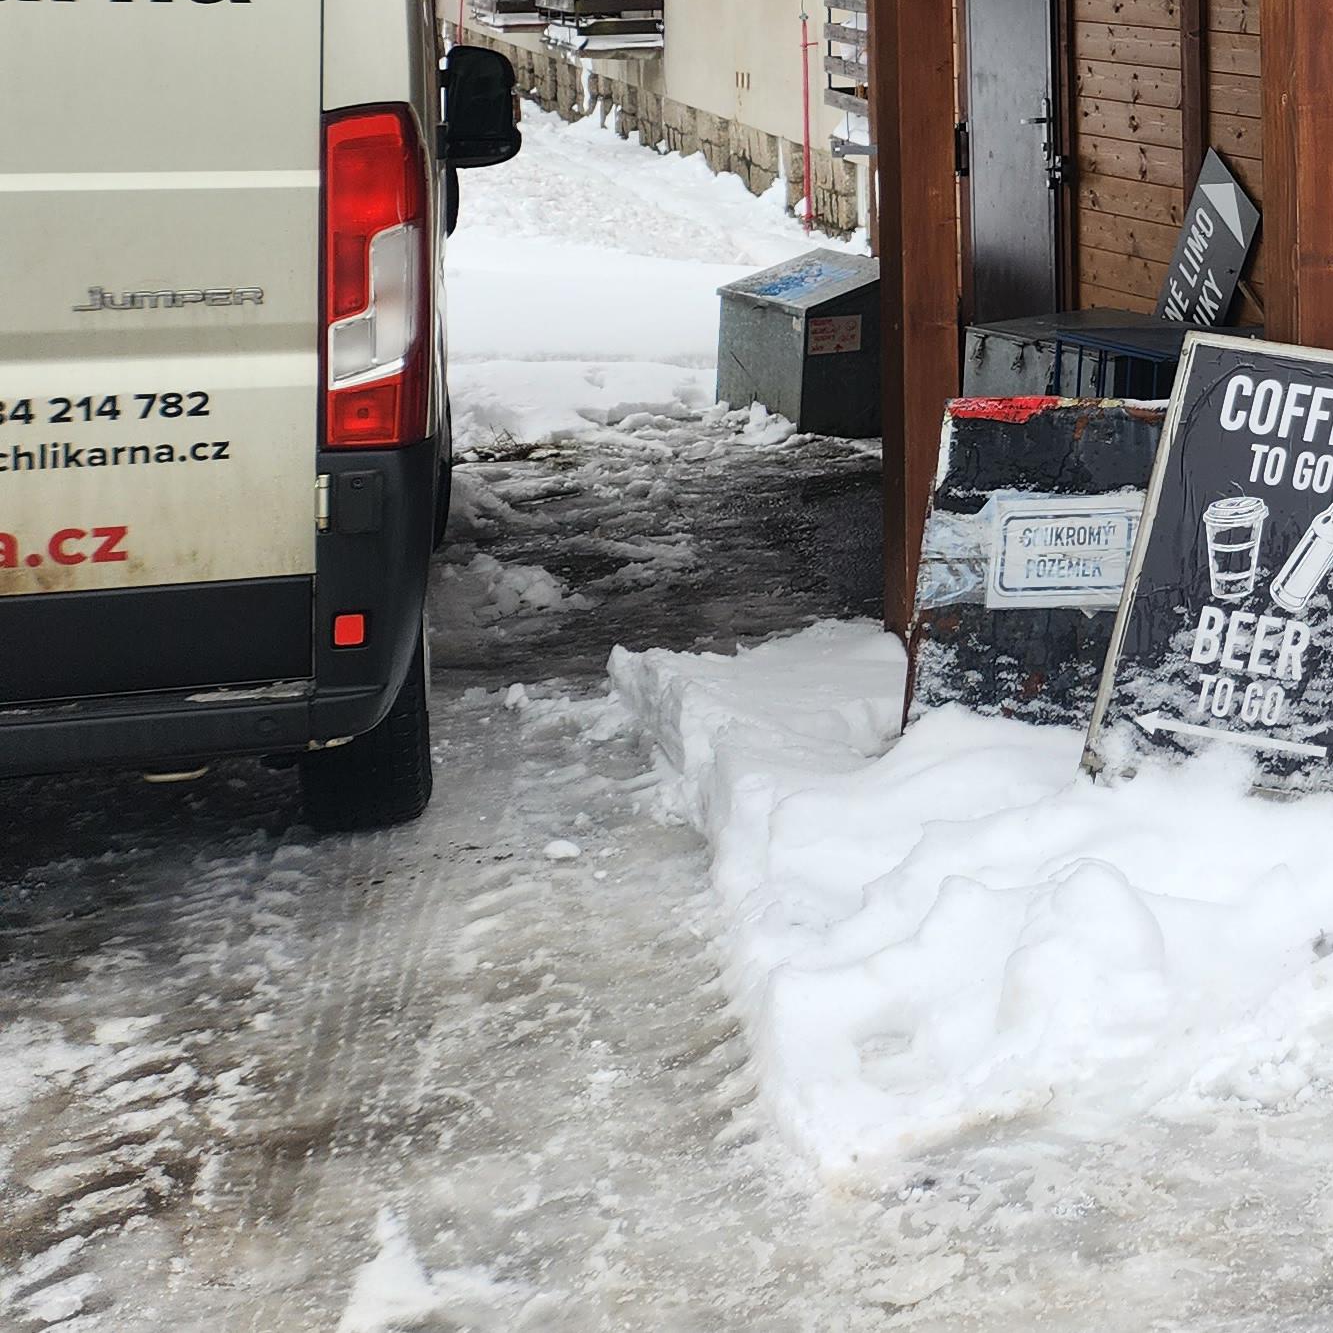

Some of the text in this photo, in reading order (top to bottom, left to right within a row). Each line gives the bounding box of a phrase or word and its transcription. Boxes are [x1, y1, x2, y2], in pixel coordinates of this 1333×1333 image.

[1178, 207, 1214, 288] LIMO
[0, 391, 211, 425] 4 214 782
[1249, 443, 1285, 485] TO
[1191, 605, 1313, 680] BEER
[1199, 673, 1286, 726] TO GO
